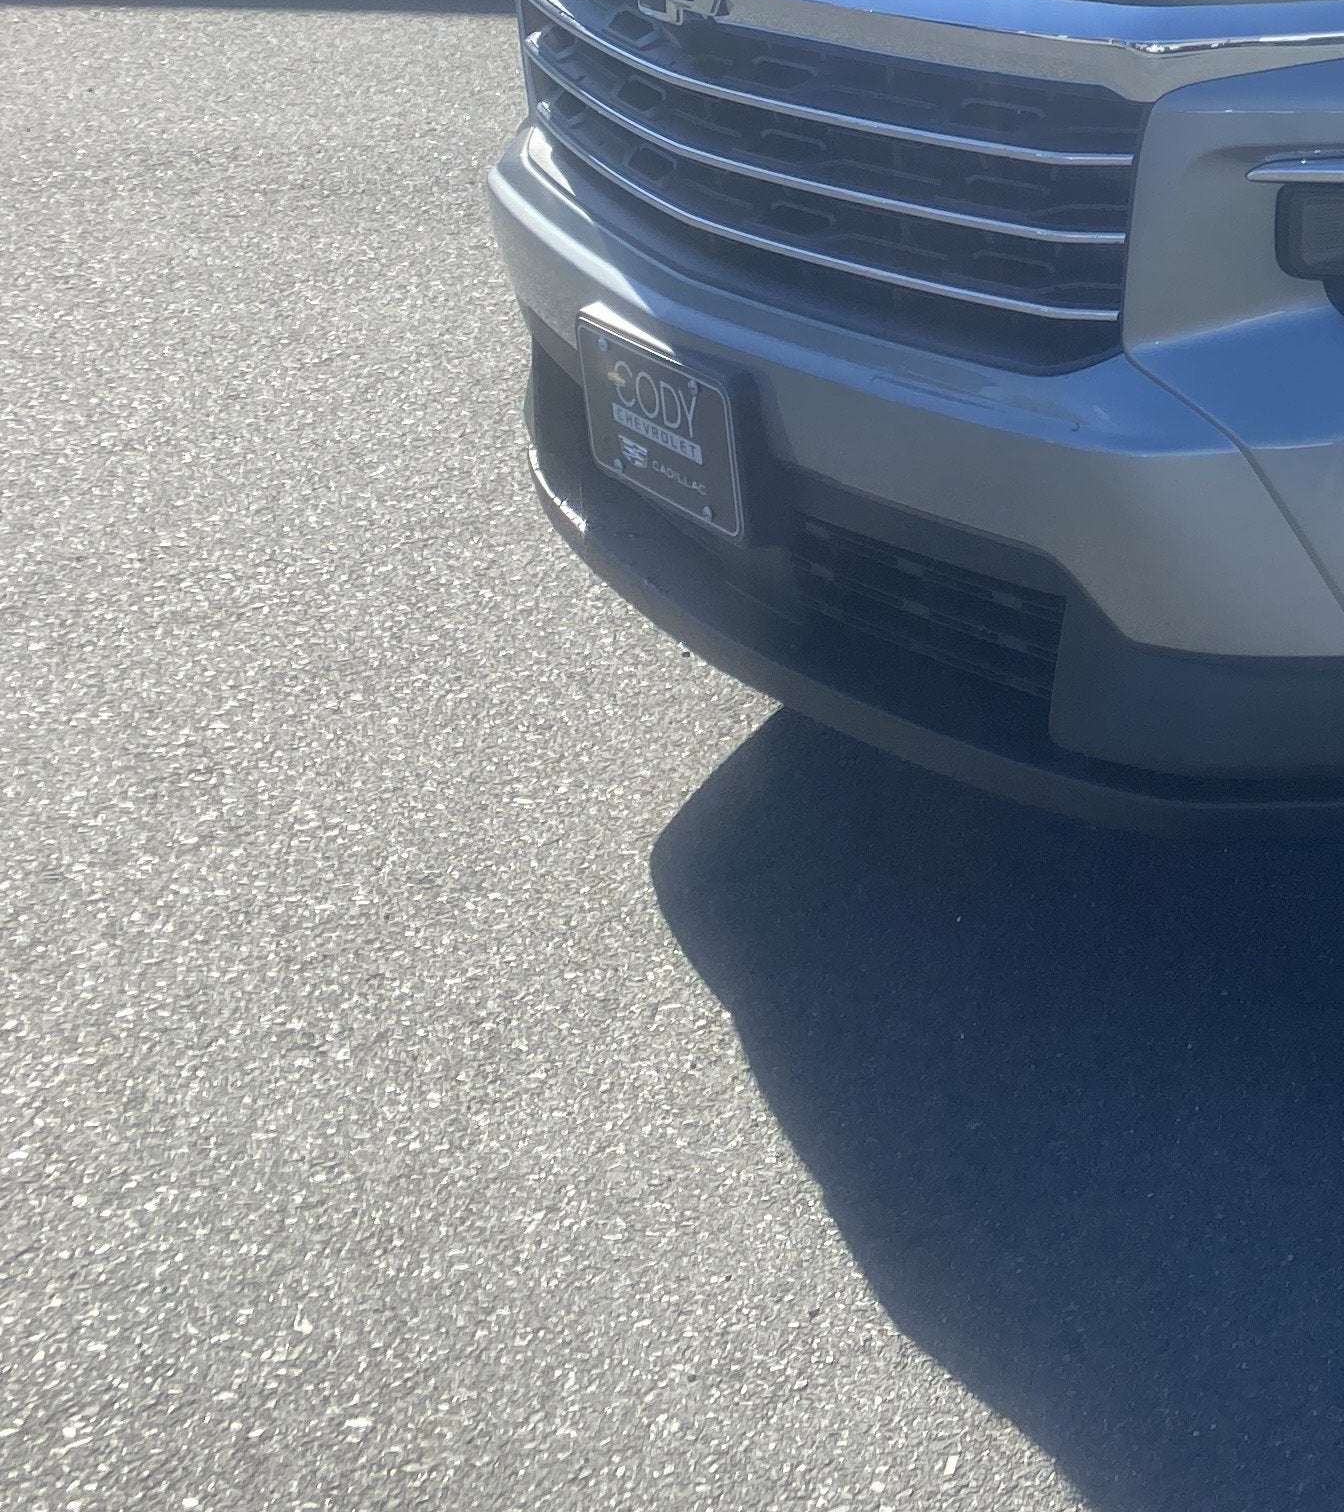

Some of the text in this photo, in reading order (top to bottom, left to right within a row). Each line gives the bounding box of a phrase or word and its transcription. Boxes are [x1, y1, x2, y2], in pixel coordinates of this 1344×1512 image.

[613, 360, 698, 438] CODY
[616, 406, 699, 458] CHEVROLET
[652, 462, 708, 495] CADILLAC
